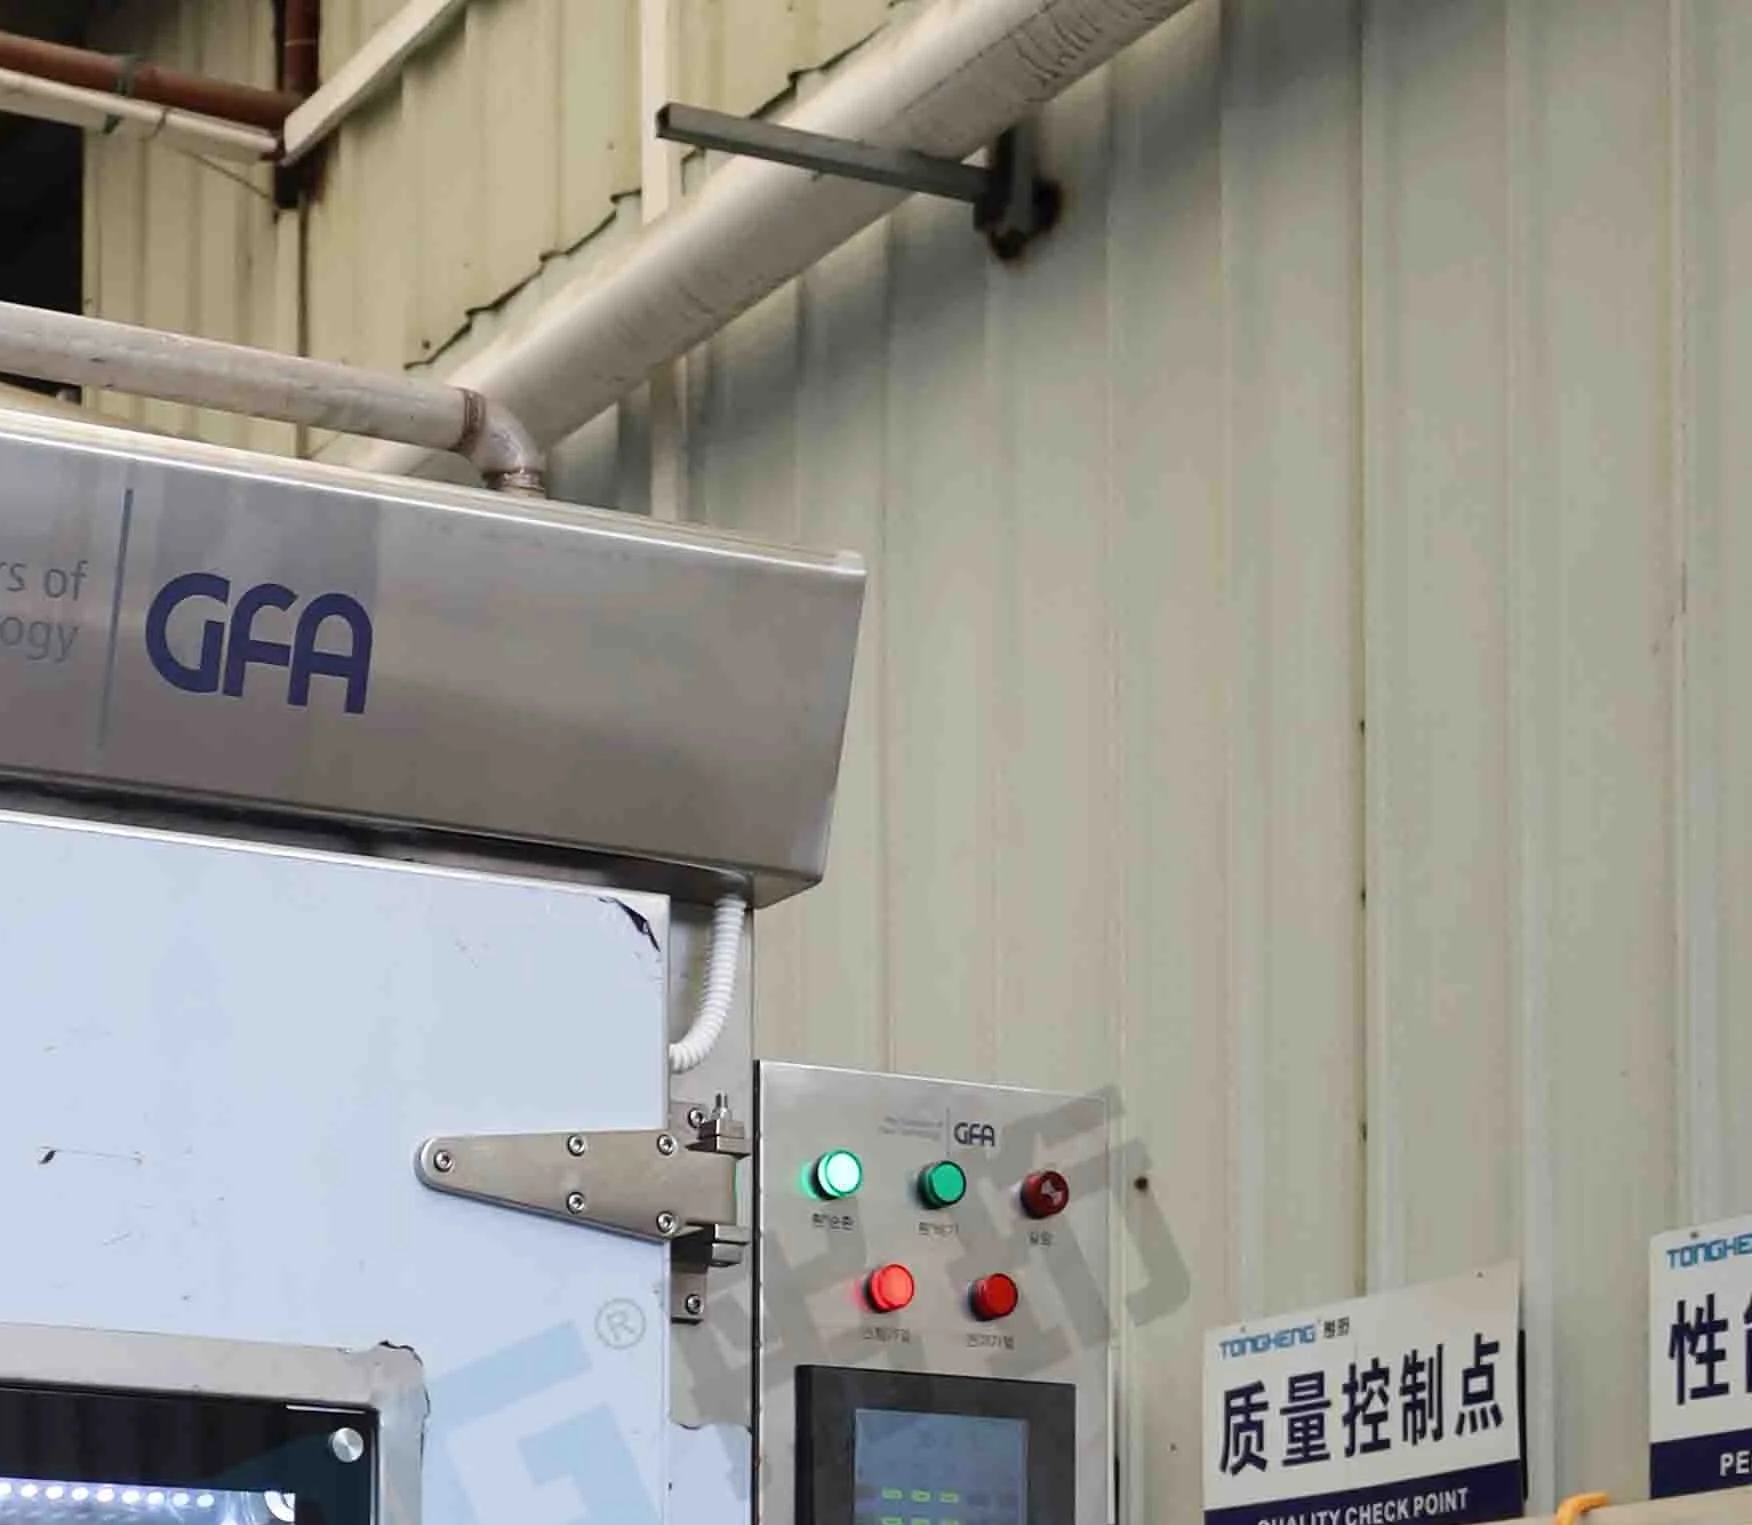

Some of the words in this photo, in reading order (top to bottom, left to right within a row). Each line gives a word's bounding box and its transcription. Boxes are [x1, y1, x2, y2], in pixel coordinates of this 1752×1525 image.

[43, 557, 89, 603] of
[144, 570, 373, 715] GFA
[953, 1121, 996, 1147] GFA
[1218, 1324, 1317, 1360] TONGHENG
[1667, 1290, 1752, 1406] 性
[1218, 1332, 1504, 1477] 质量控制点
[1412, 1487, 1470, 1519] POINT
